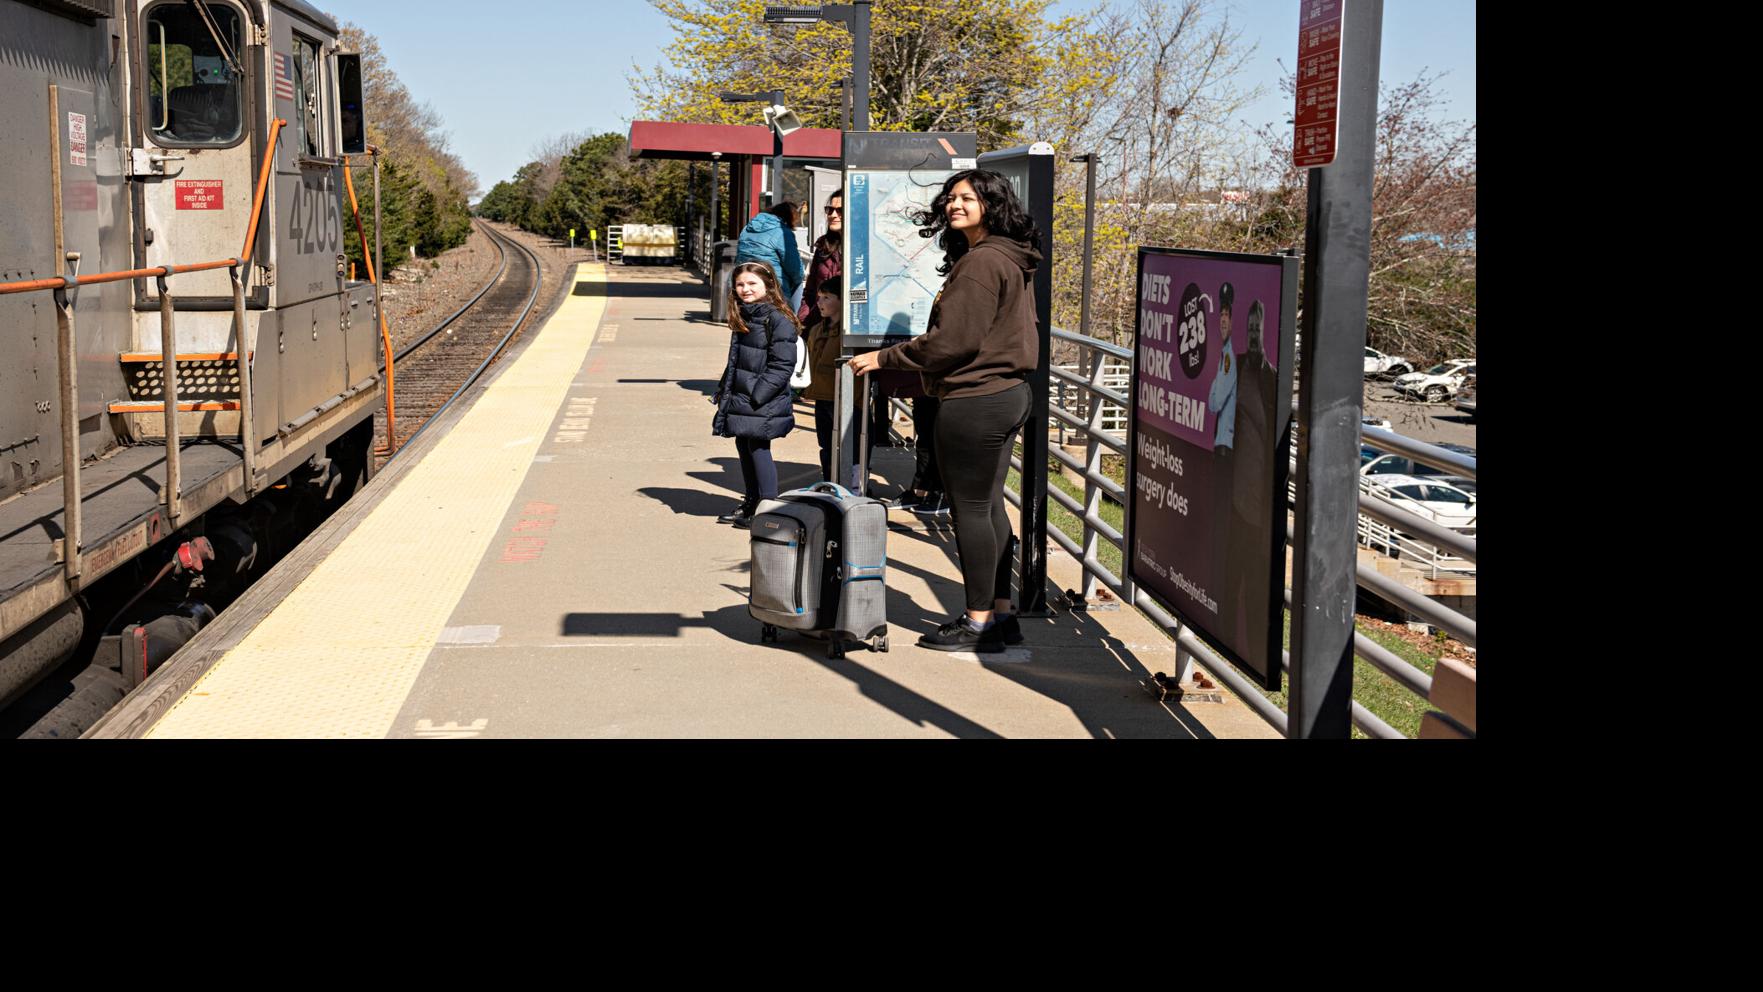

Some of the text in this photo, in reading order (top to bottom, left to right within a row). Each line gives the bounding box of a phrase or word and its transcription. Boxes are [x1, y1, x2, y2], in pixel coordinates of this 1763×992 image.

[289, 180, 338, 255] 4205
[856, 254, 864, 275] RAIL
[1141, 273, 1171, 305] DIETS
[1184, 296, 1198, 318] LOST
[1140, 309, 1174, 344] DON'T
[1179, 310, 1206, 355] 238
[1139, 344, 1173, 382] WORK
[1189, 350, 1200, 368] lbs!
[1138, 379, 1206, 433] LONG-TERM
[1137, 431, 1184, 477] Weight-loss
[1136, 471, 1189, 516] surgery does
